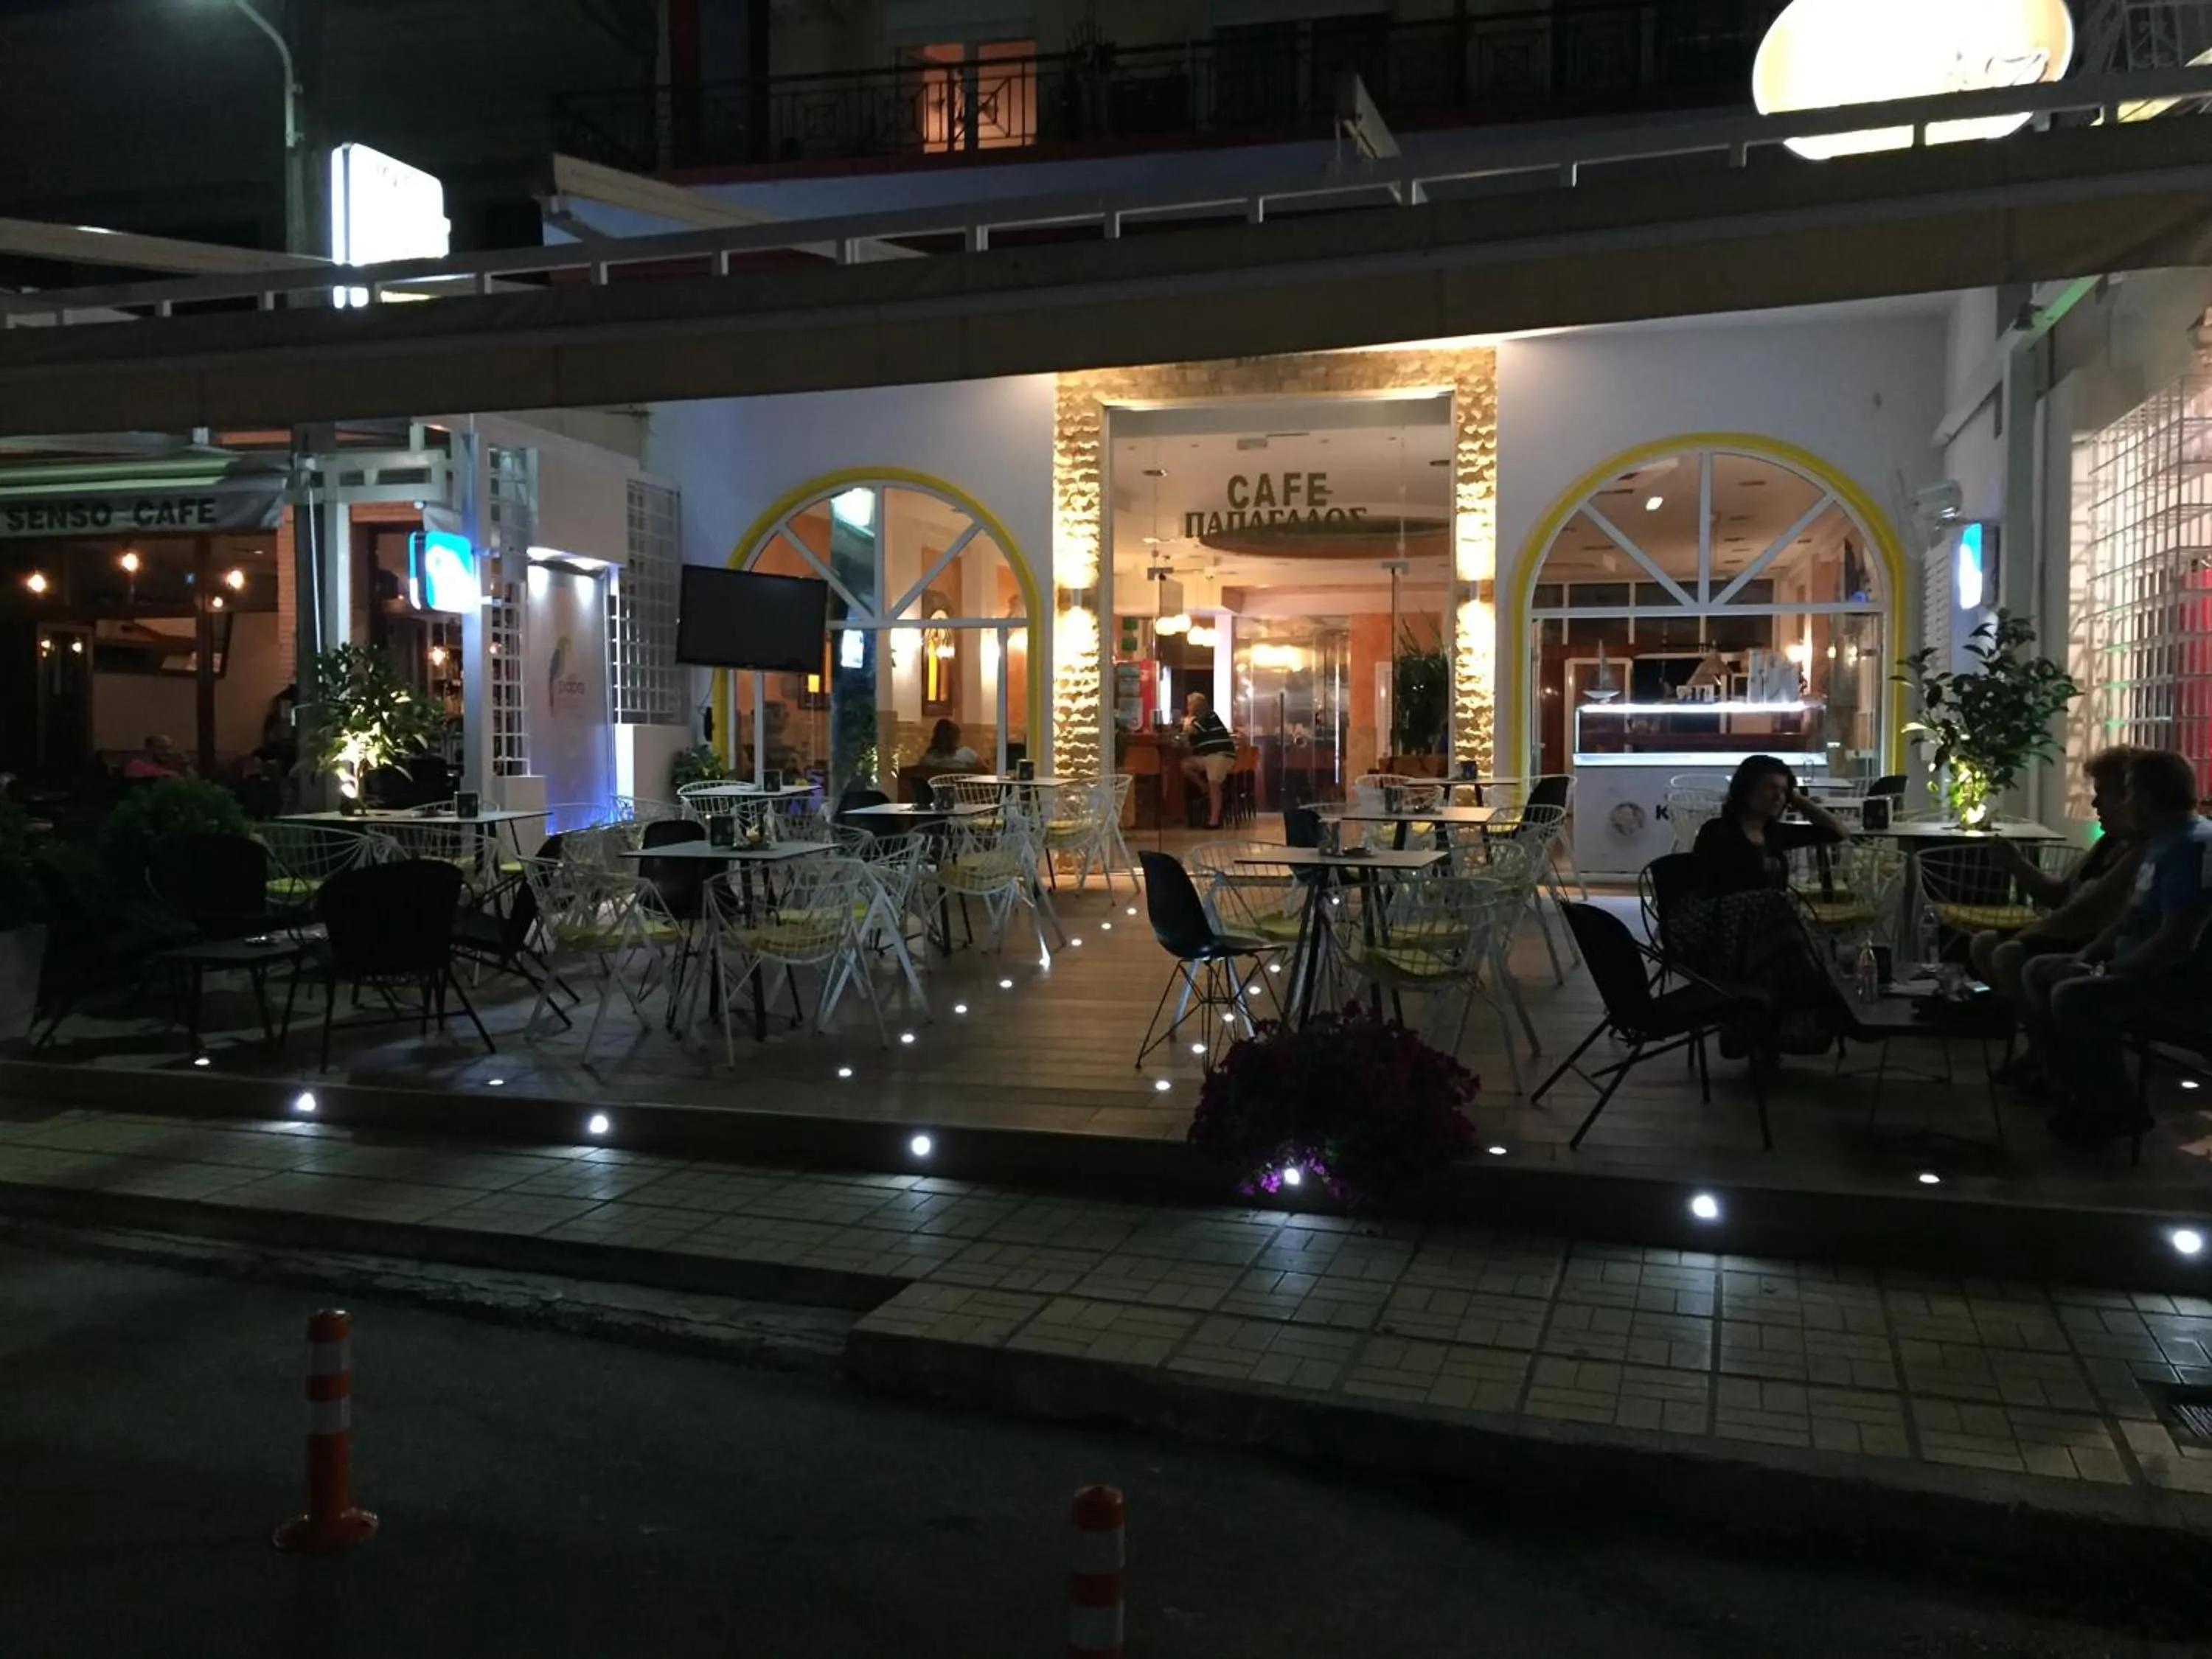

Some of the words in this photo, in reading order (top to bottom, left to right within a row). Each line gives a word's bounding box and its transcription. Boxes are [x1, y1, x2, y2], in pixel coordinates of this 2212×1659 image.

[1227, 472, 1327, 509] CAFE
[7, 502, 112, 532] SENSO
[133, 498, 216, 526] CAFE
